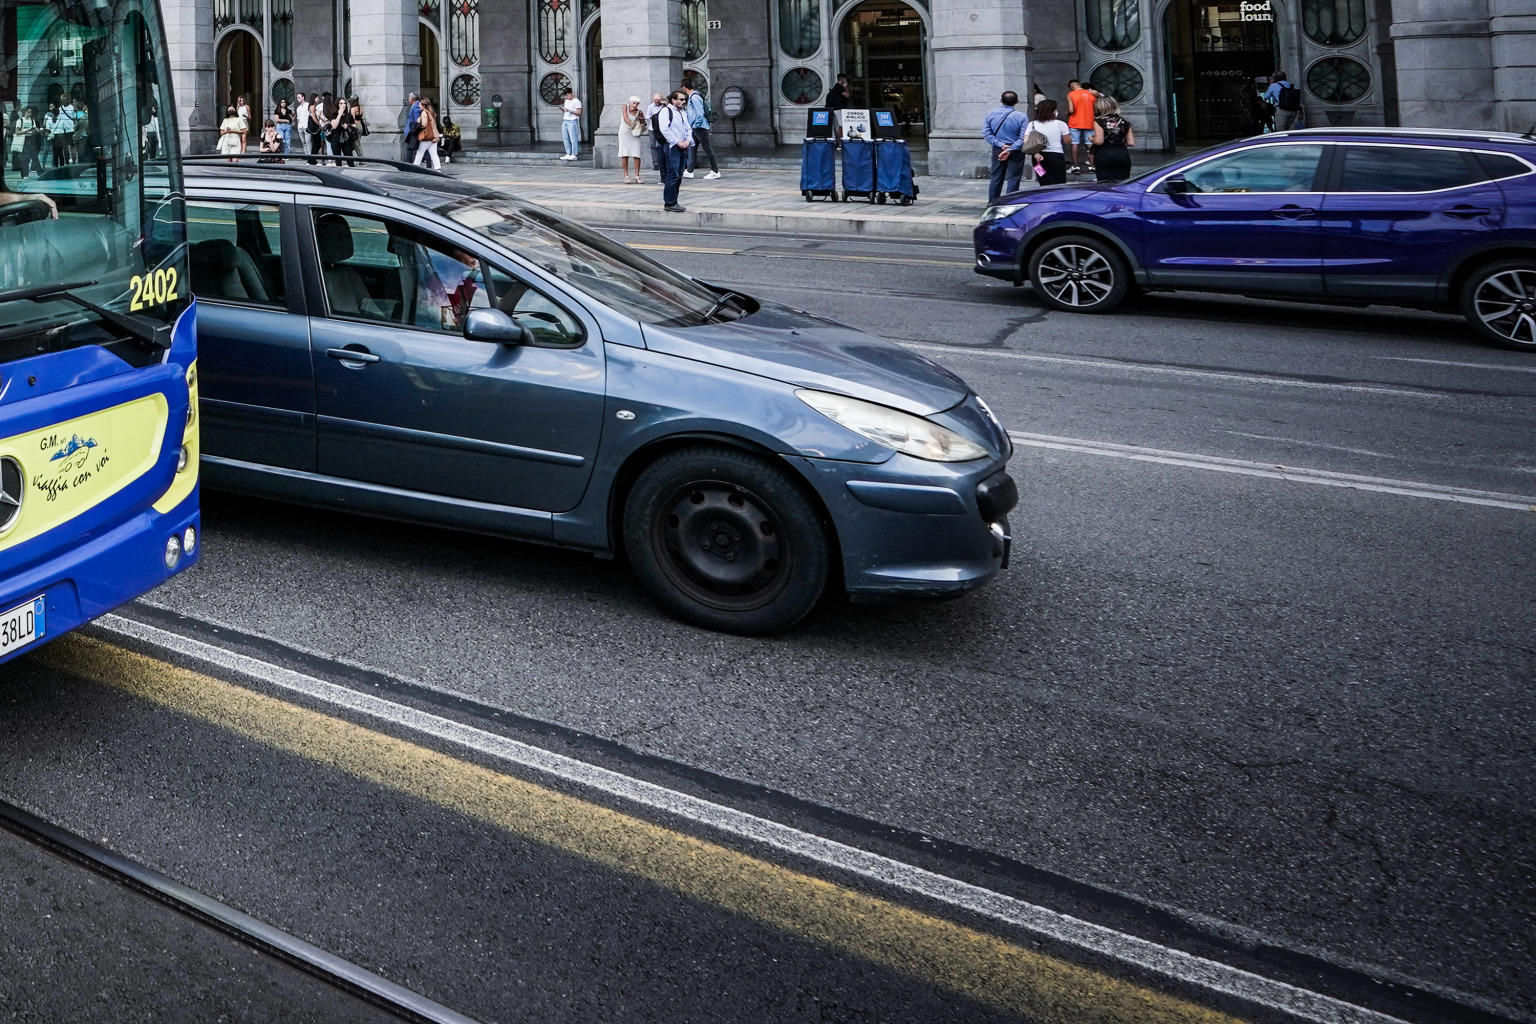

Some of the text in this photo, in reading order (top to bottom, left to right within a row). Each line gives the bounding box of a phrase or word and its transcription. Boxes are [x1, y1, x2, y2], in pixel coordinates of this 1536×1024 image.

[1240, 0, 1271, 12] food
[130, 267, 178, 312] 2402
[40, 434, 59, 450] G.M.
[73, 471, 92, 488] con
[96, 448, 110, 472] voi
